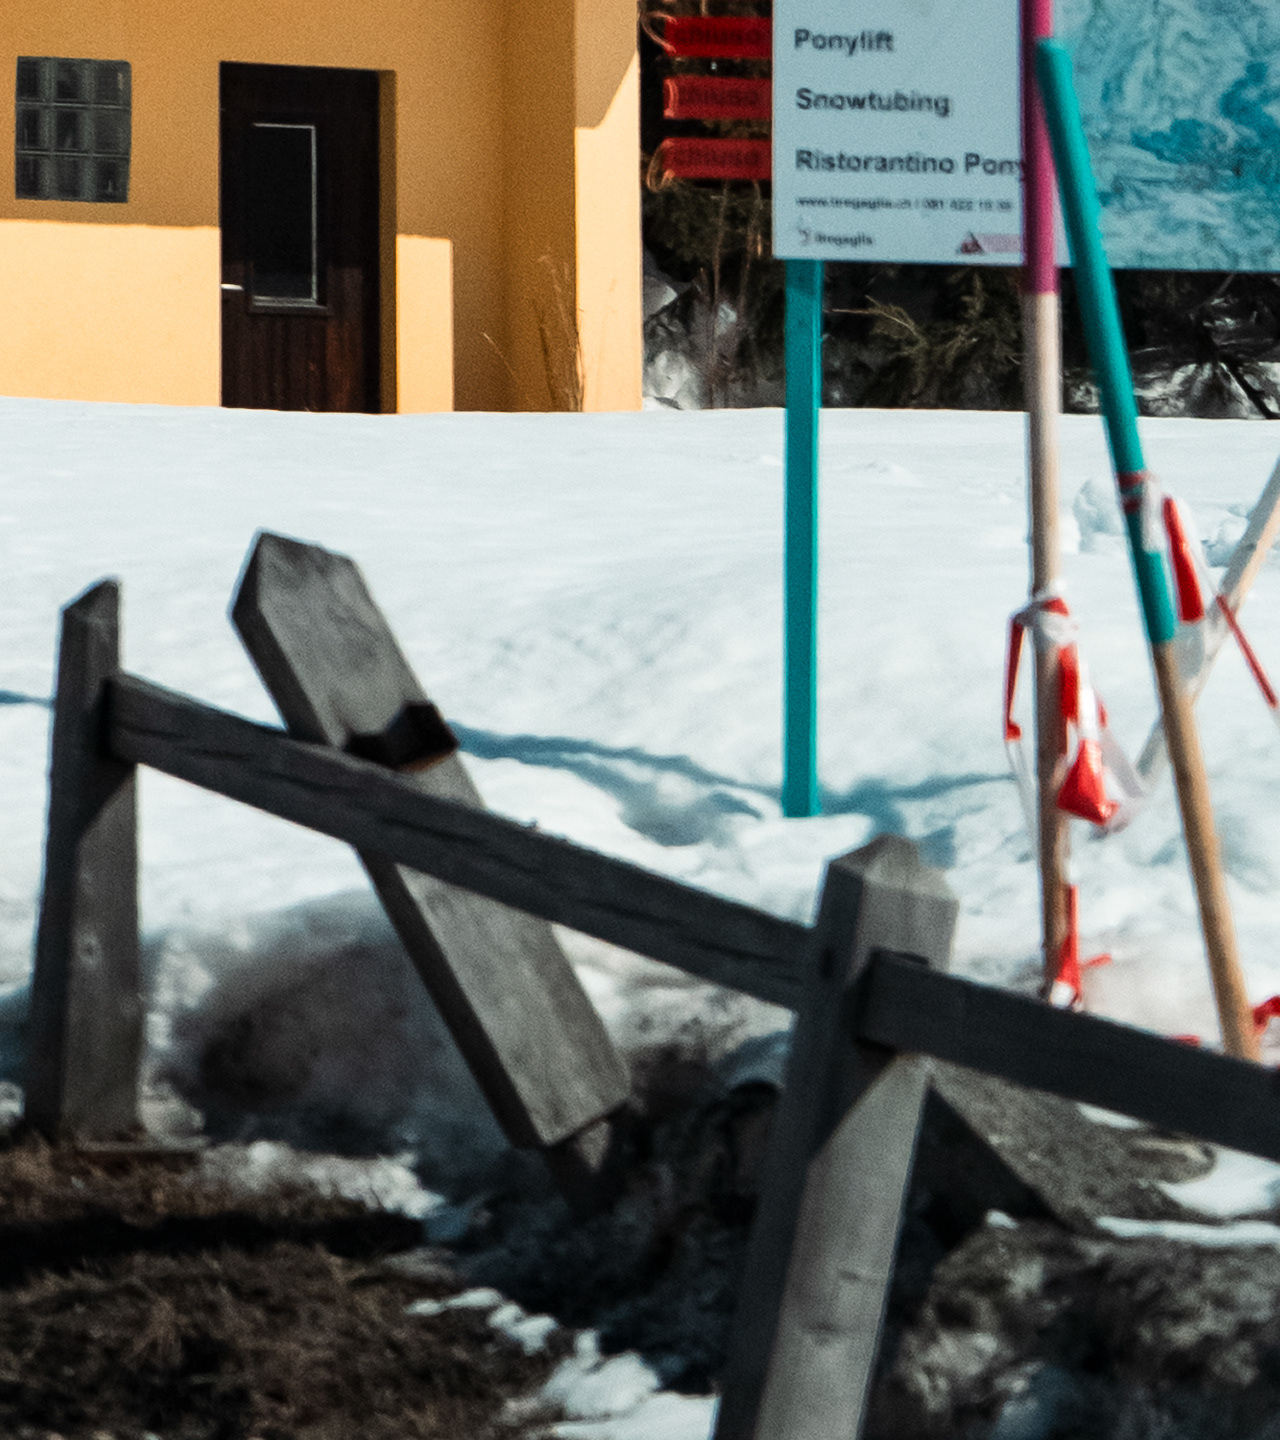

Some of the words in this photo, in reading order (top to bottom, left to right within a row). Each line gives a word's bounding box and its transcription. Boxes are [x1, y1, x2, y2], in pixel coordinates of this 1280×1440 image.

[794, 28, 894, 57] Ponylift
[796, 87, 950, 118] Snowtubing
[796, 149, 955, 174] Ristorantino
